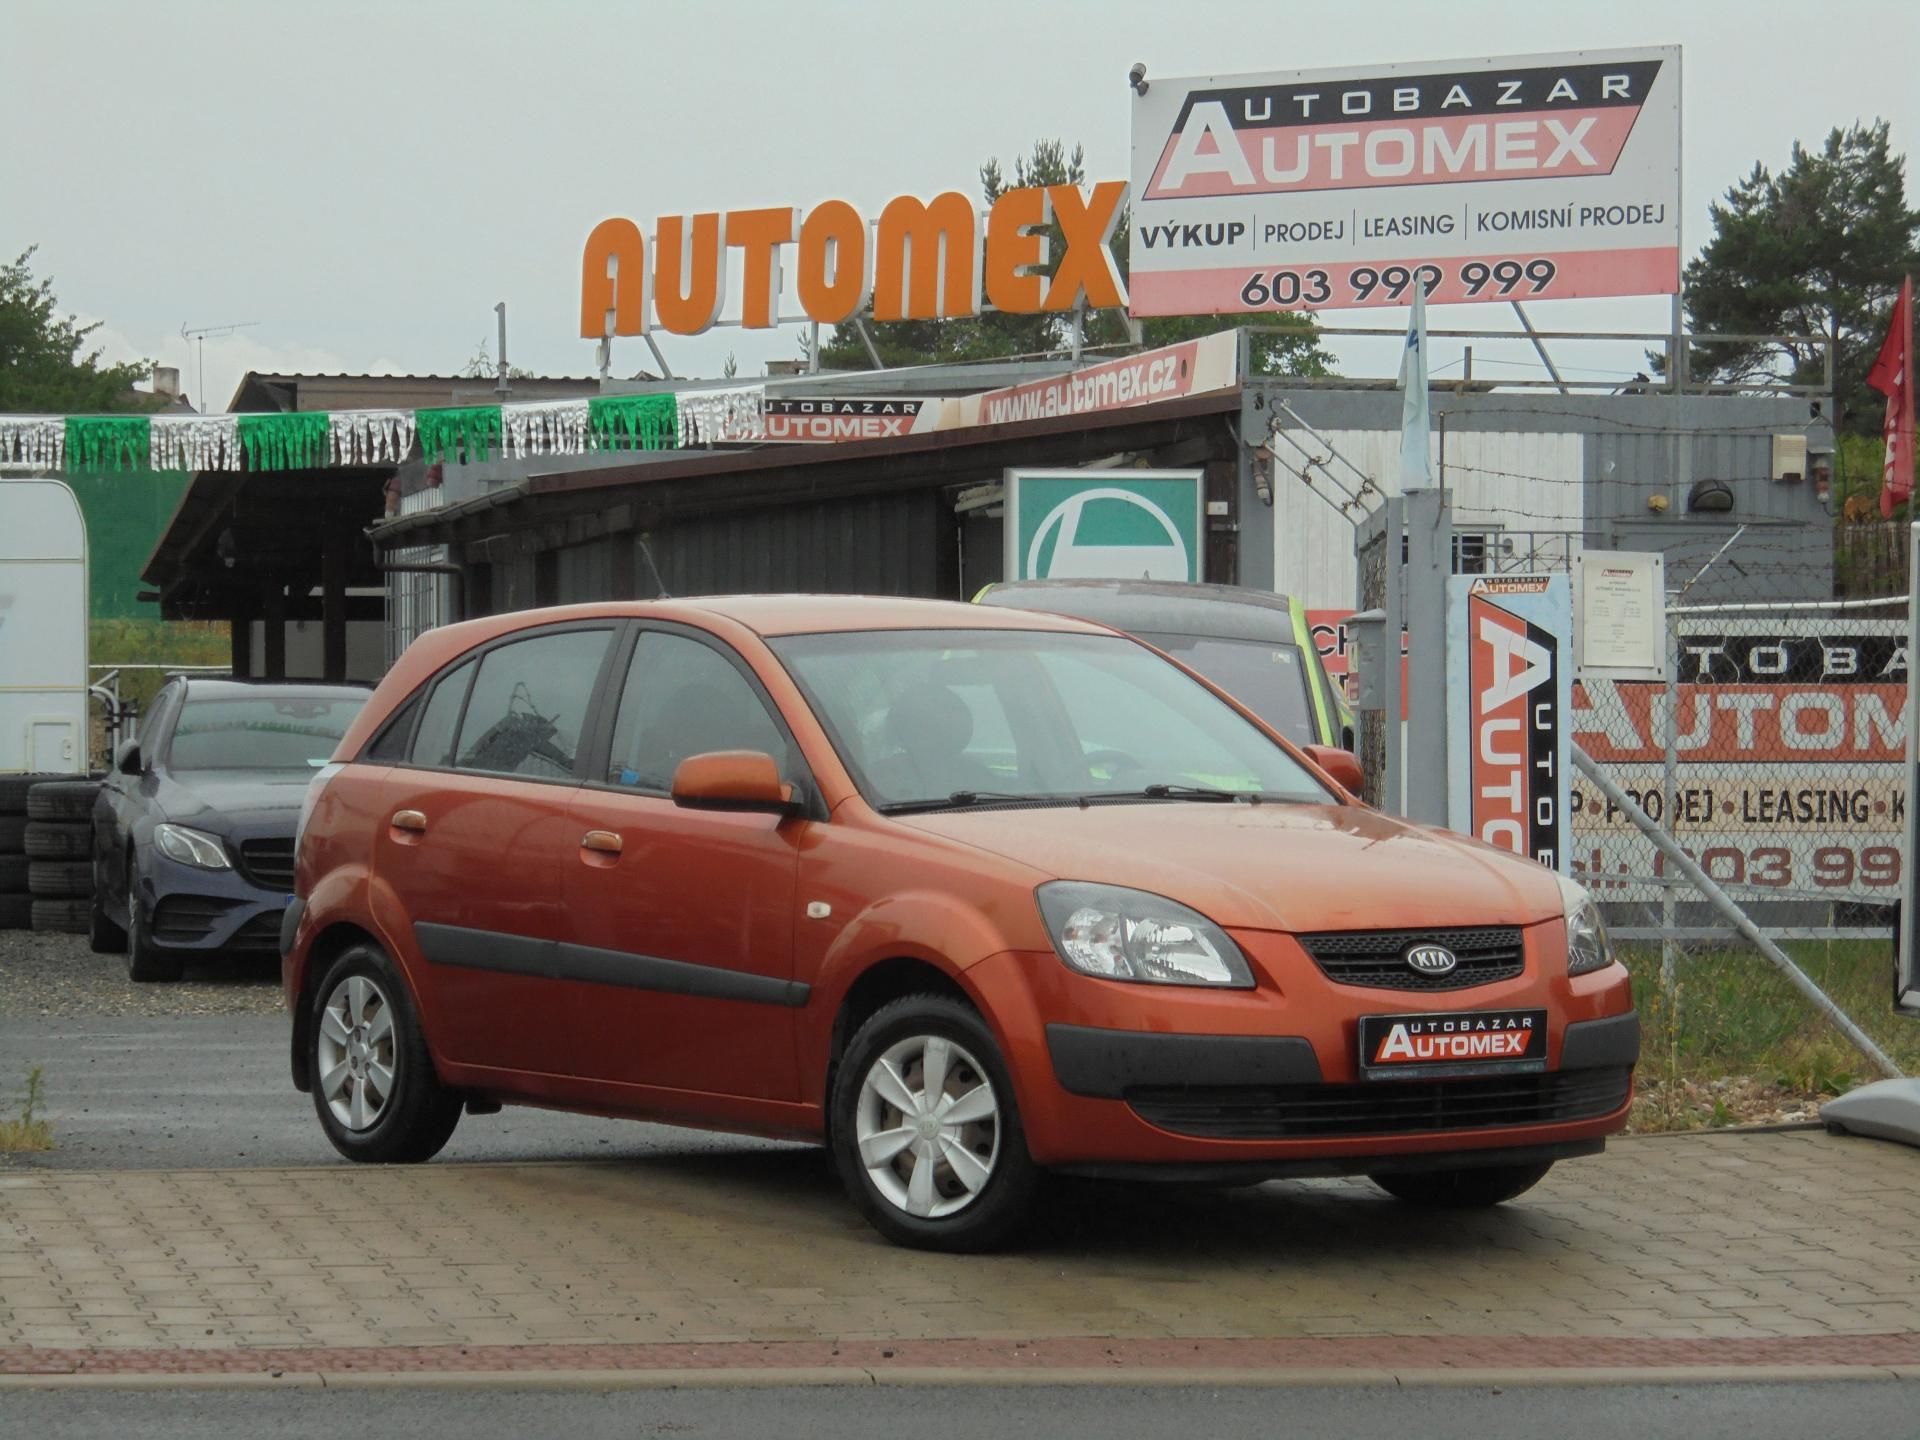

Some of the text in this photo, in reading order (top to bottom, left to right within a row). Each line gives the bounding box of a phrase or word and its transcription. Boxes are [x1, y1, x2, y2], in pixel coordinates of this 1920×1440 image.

[1157, 101, 1599, 191] AUTOMEX
[1140, 202, 1665, 249] VÝKUP PRODEJ LEASING KOMISNÍ PRODEJ
[580, 180, 1130, 339] AUTOMEX
[1240, 259, 1556, 306] 603 999 999
[989, 355, 1177, 425] www.automex.cz
[1471, 579, 1544, 594] AUTOMEX
[1743, 789, 1869, 824] LEASING
[1415, 951, 1451, 967] KIA
[1380, 1023, 1523, 1059] AUTOMEX
